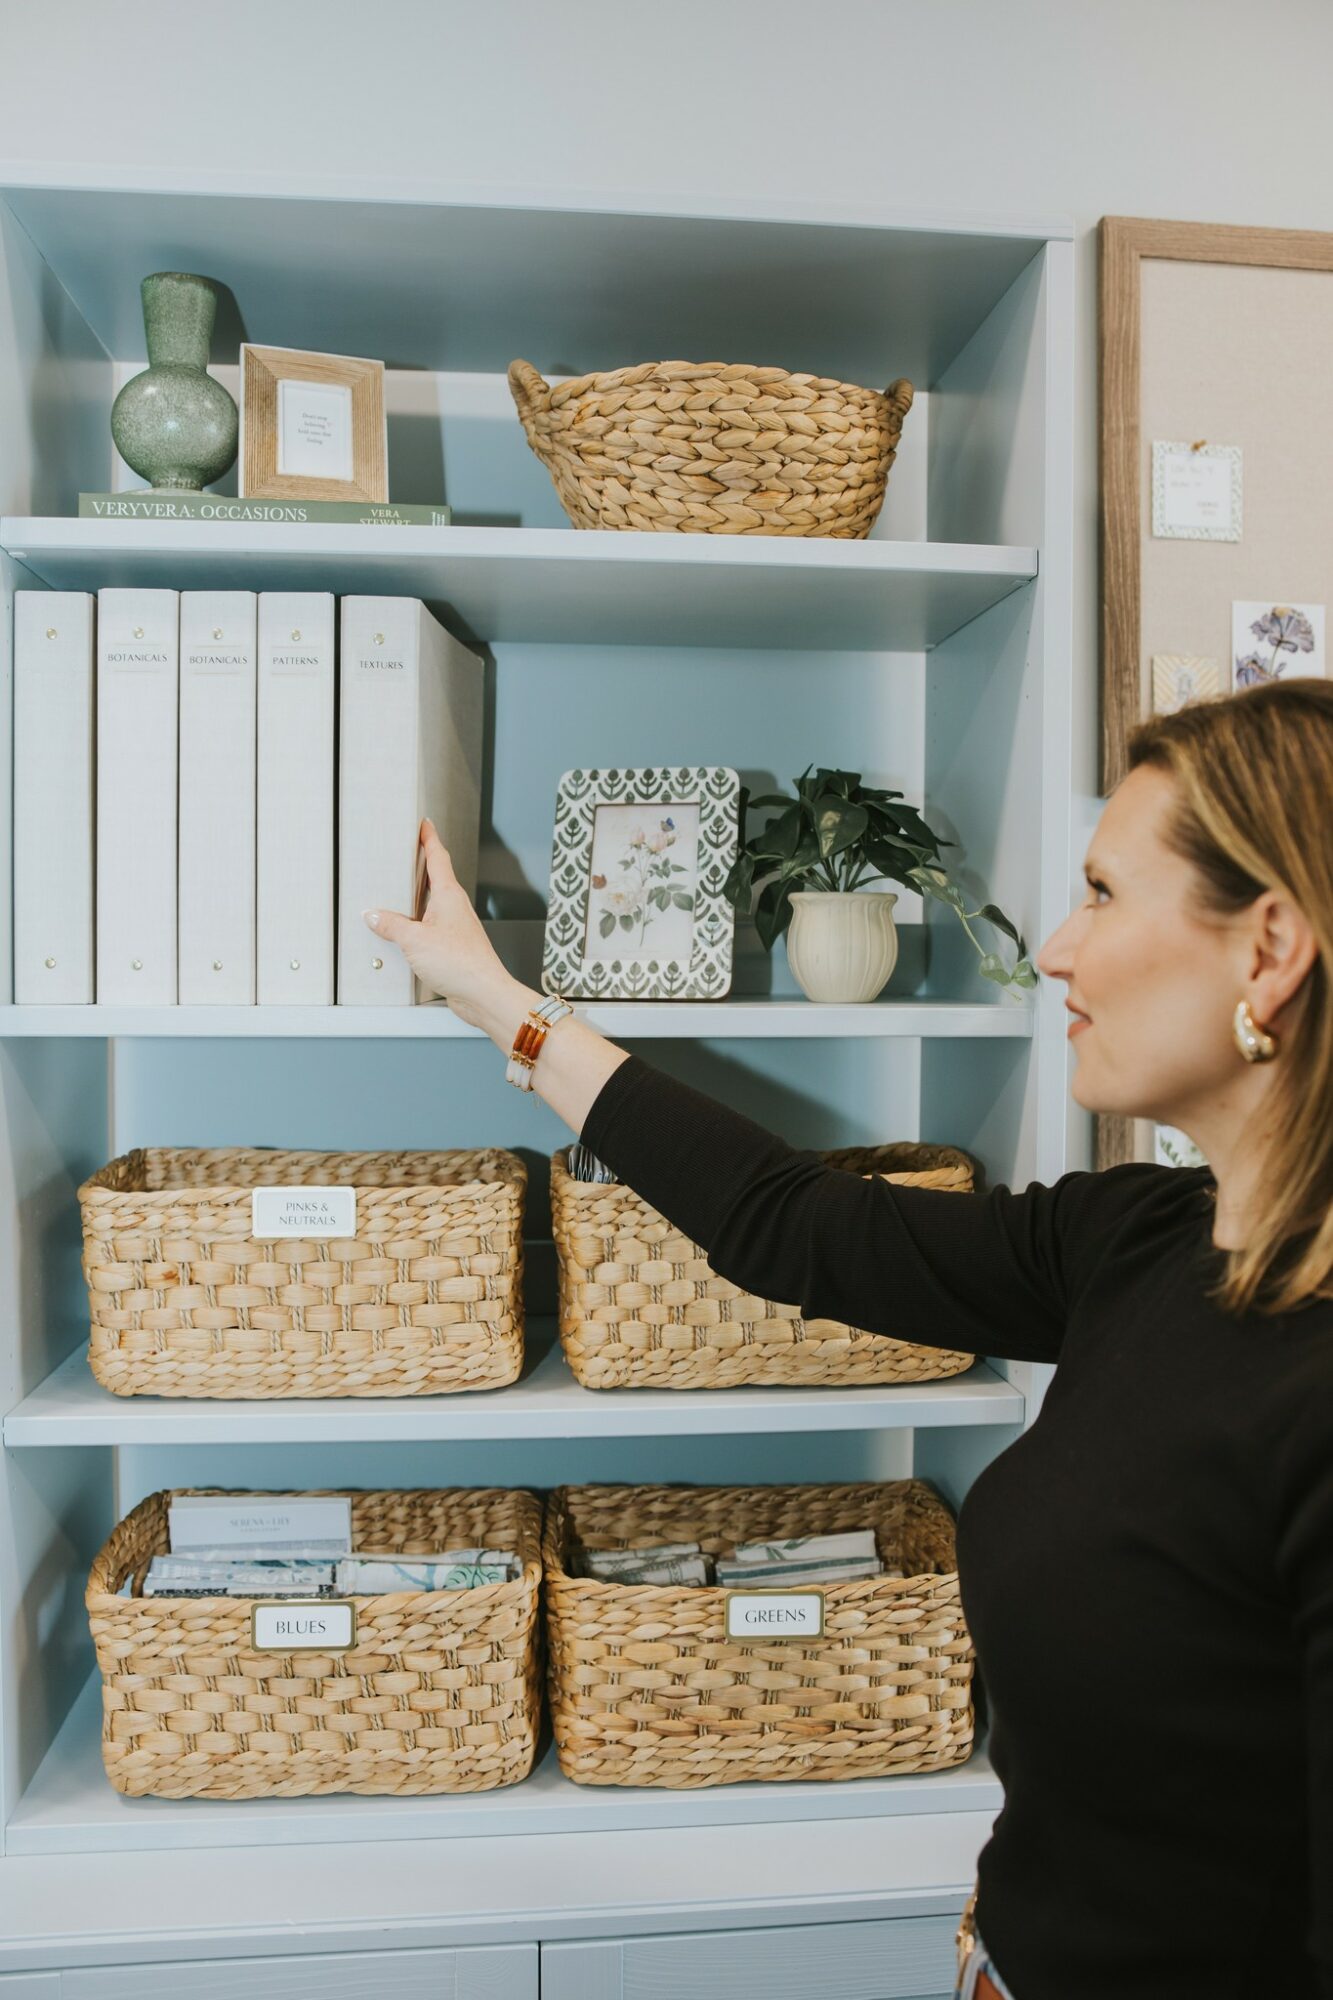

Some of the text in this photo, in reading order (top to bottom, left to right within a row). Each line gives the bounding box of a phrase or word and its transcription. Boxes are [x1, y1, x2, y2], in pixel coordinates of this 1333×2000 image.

[92, 501, 308, 523] VERYVERA: OCCASIONS
[371, 508, 401, 519] VERA
[107, 653, 168, 663] BOTANICALS
[189, 655, 248, 665] BOTANICALS
[272, 656, 319, 666] PATTERNS
[359, 660, 404, 670] TEXTURES
[285, 1202, 329, 1212] PINKS &
[279, 1215, 337, 1226] NEUTRALS
[744, 1607, 807, 1624] GREENS
[275, 1619, 327, 1635] BLUES
